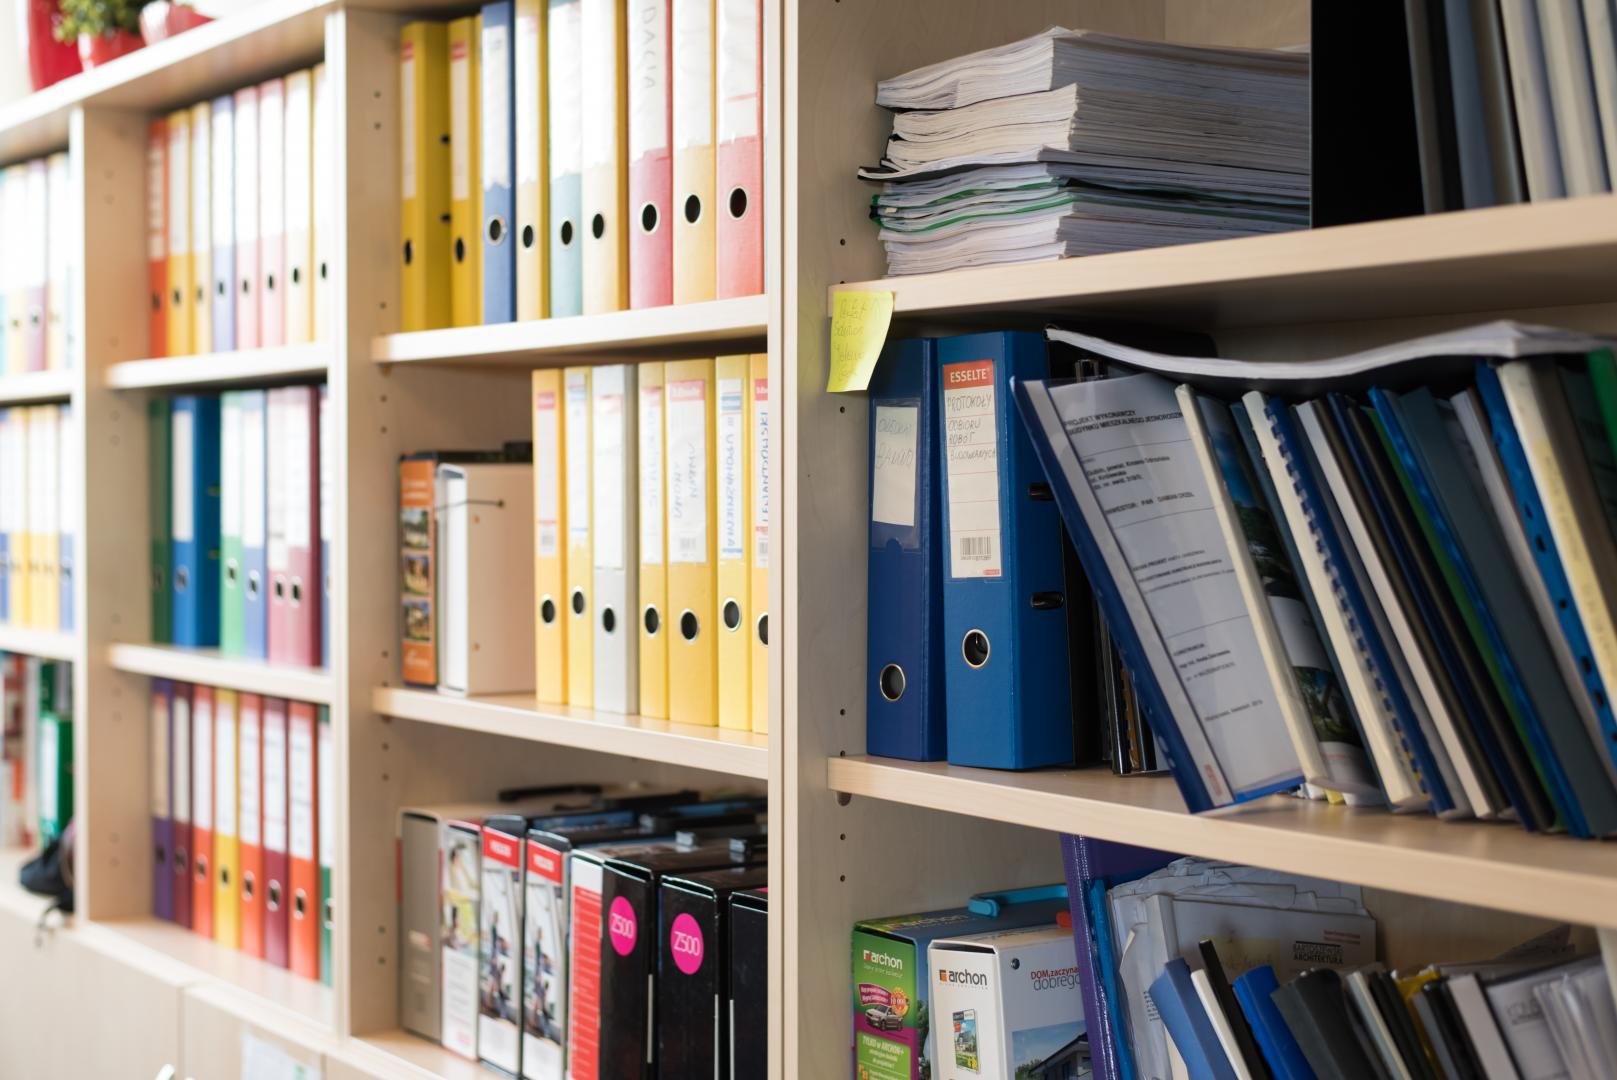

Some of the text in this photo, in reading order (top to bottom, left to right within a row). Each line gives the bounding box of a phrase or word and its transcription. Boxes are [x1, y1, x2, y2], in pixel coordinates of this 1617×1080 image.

[640, 6, 656, 88] DACIA
[950, 368, 987, 383] ESSELTE
[612, 912, 633, 940] Z500
[674, 931, 700, 956] Z500
[870, 951, 903, 970] archon
[949, 969, 987, 986] archon
